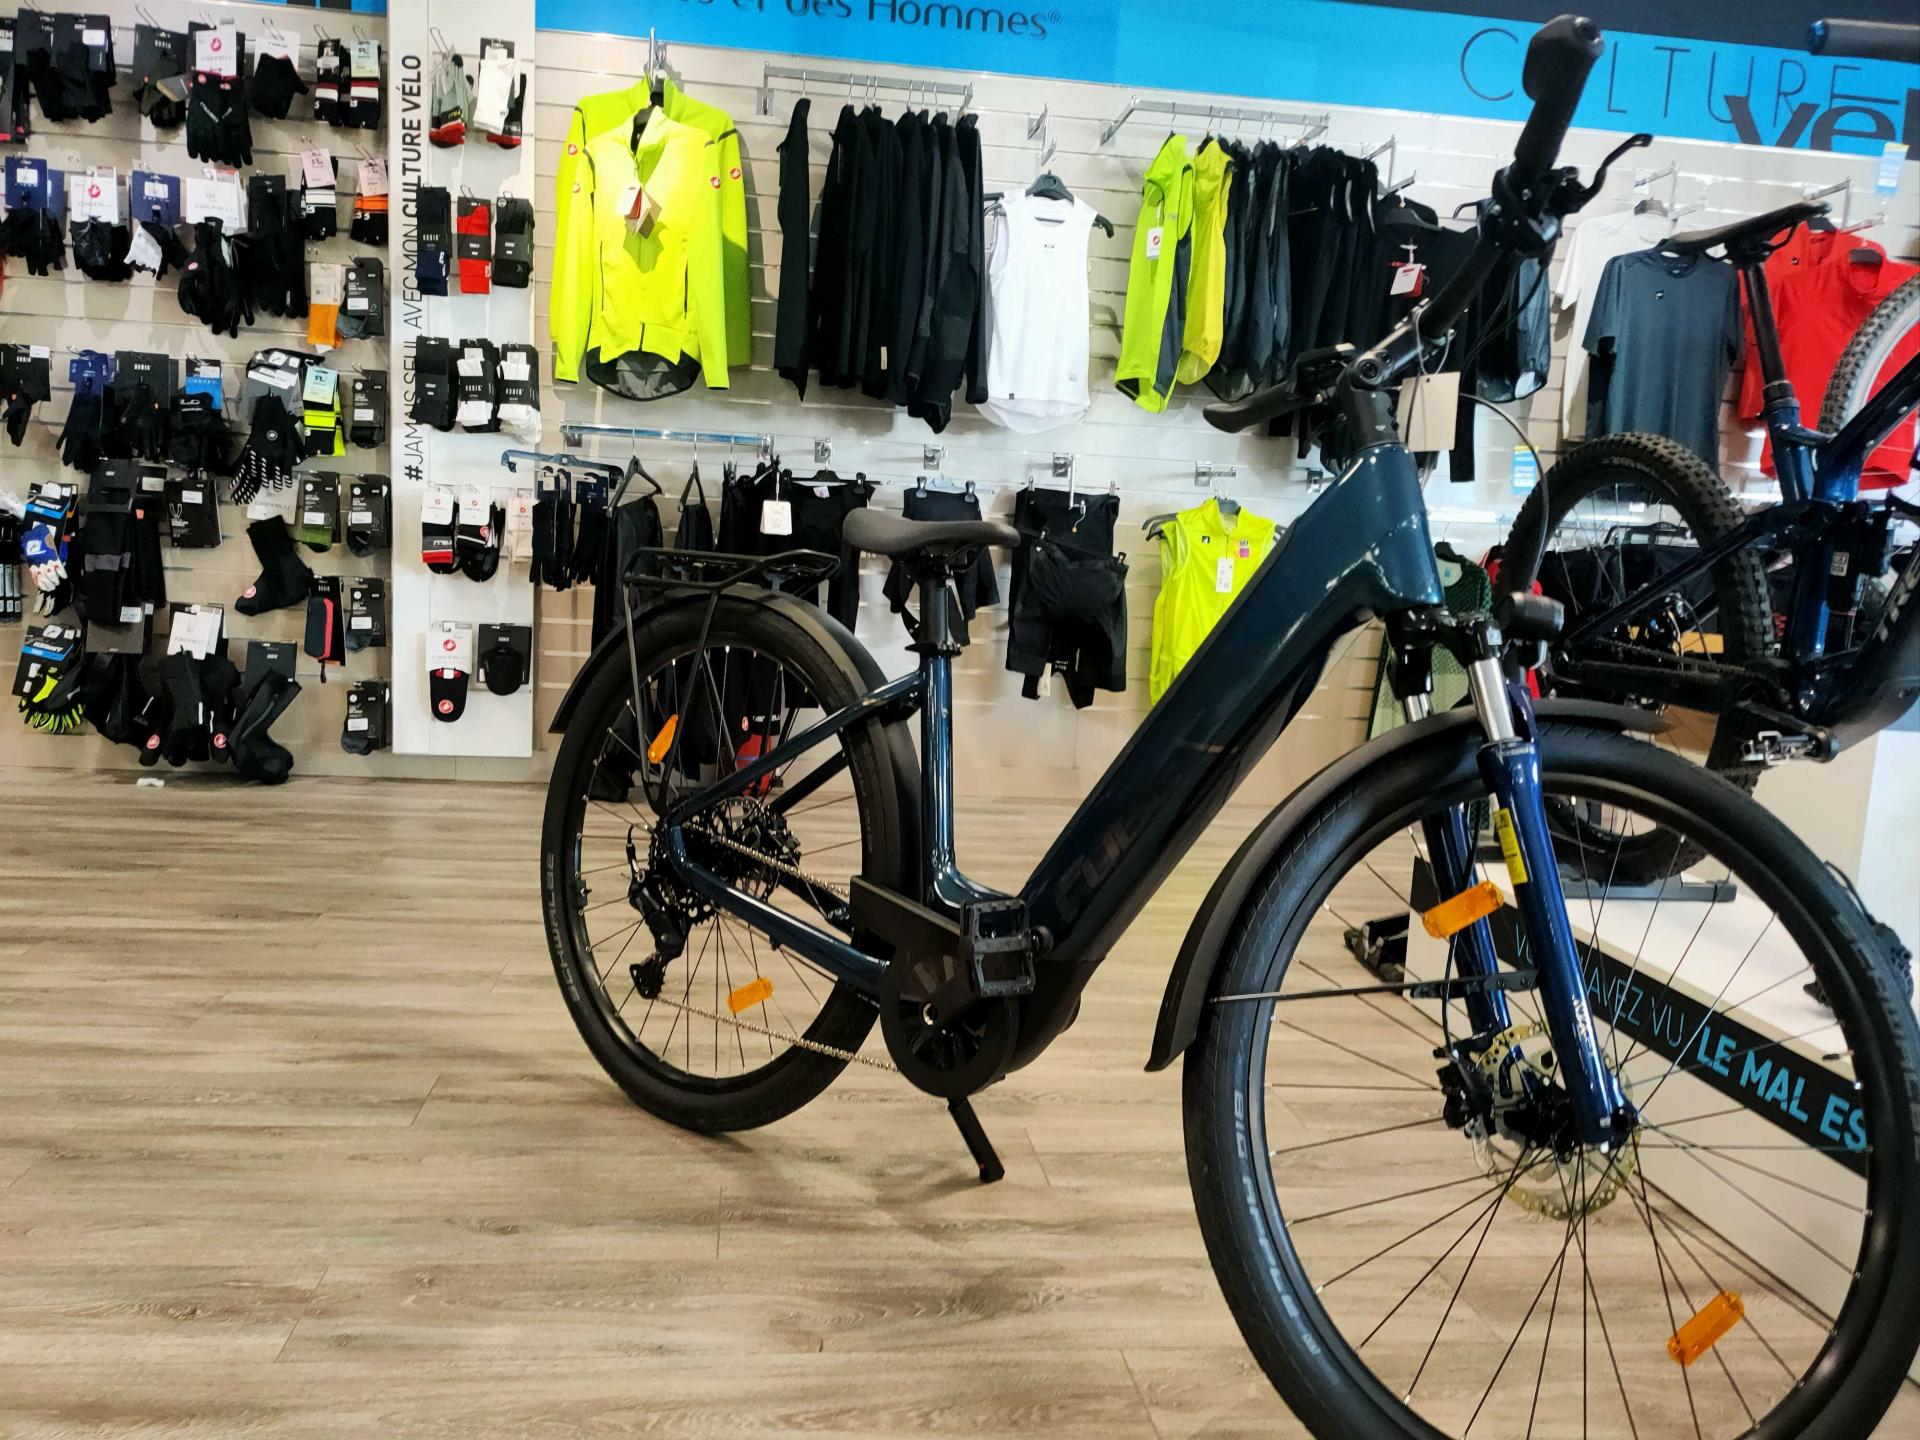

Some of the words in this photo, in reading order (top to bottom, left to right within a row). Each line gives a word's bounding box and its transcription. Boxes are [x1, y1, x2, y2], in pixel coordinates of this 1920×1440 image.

[396, 55, 422, 112] VÉLO
[1460, 27, 1862, 129] CLTURE
[402, 118, 422, 218] CULTURE
[402, 223, 419, 272] MON
[402, 276, 423, 330] AVEC
[1696, 1025, 1738, 1078] LE
[1739, 1049, 1809, 1123] MAL
[1819, 1093, 1868, 1153] ES
